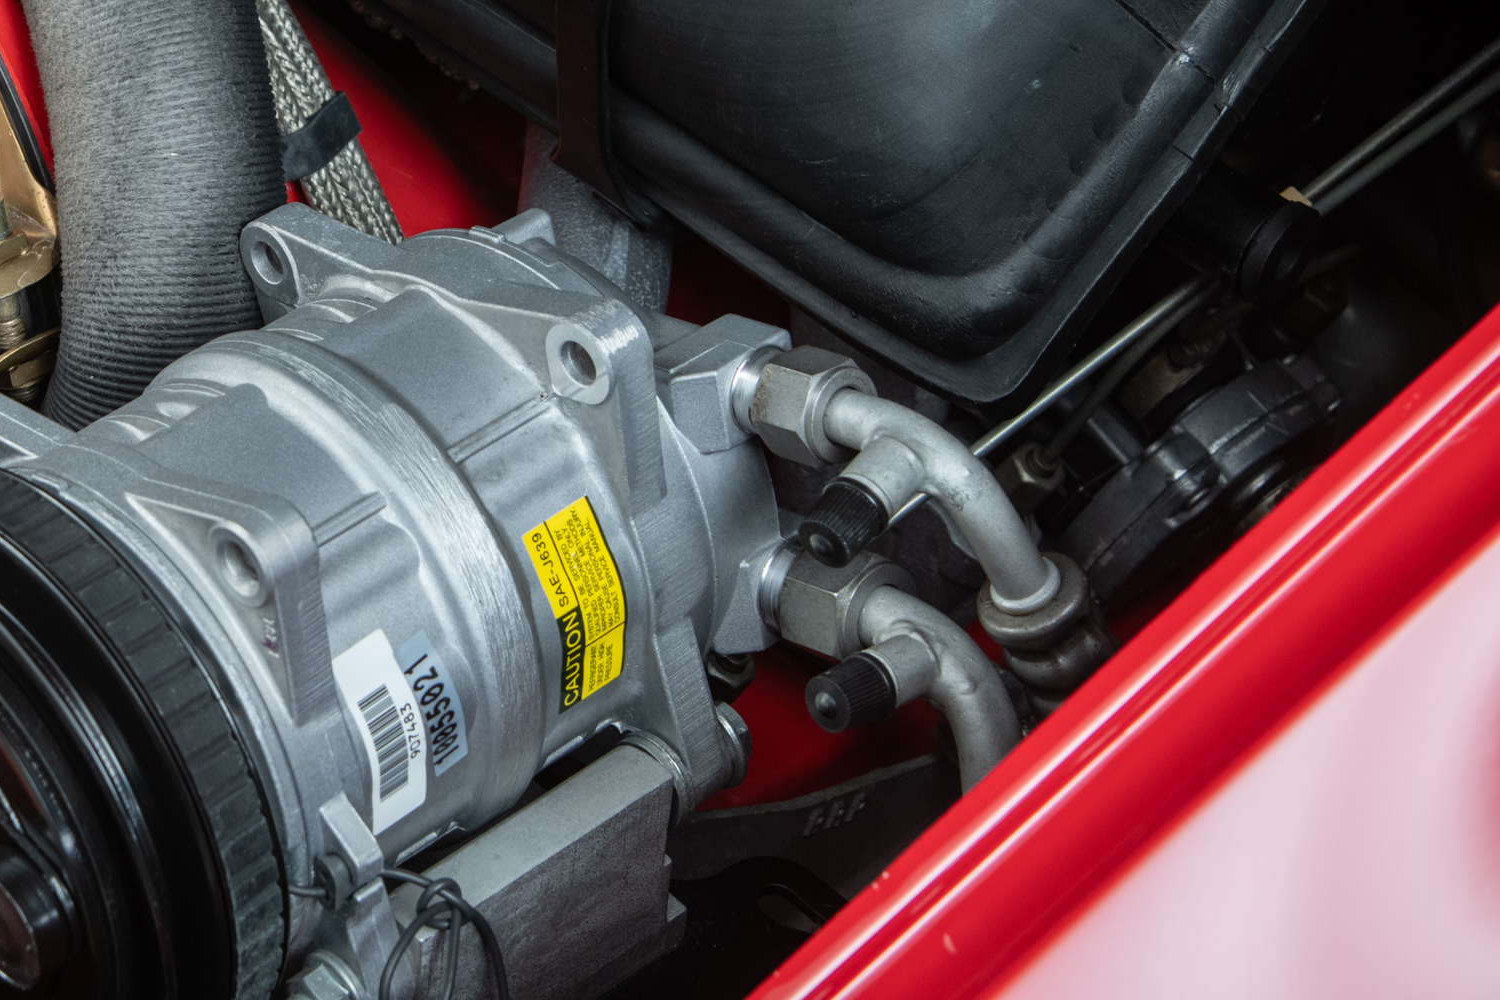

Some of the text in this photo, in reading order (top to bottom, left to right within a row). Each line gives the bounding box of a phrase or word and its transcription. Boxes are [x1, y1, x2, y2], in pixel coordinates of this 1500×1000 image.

[531, 532, 569, 608] SAE-J639
[566, 519, 607, 632] IMPROPER SERVICE METHODS
[572, 550, 594, 597] PERSONNEL
[584, 539, 604, 581] PERSONAL
[599, 554, 615, 588] SERVICE
[554, 529, 594, 640] SYSTEM TO BE SERVICED BY
[601, 583, 612, 609] CAUSE
[590, 599, 600, 636] QUALIFIED
[610, 590, 620, 624] CONSULT
[562, 611, 581, 706] CAUTION
[604, 643, 613, 681] PRESSURE
[400, 703, 420, 759] 907483
